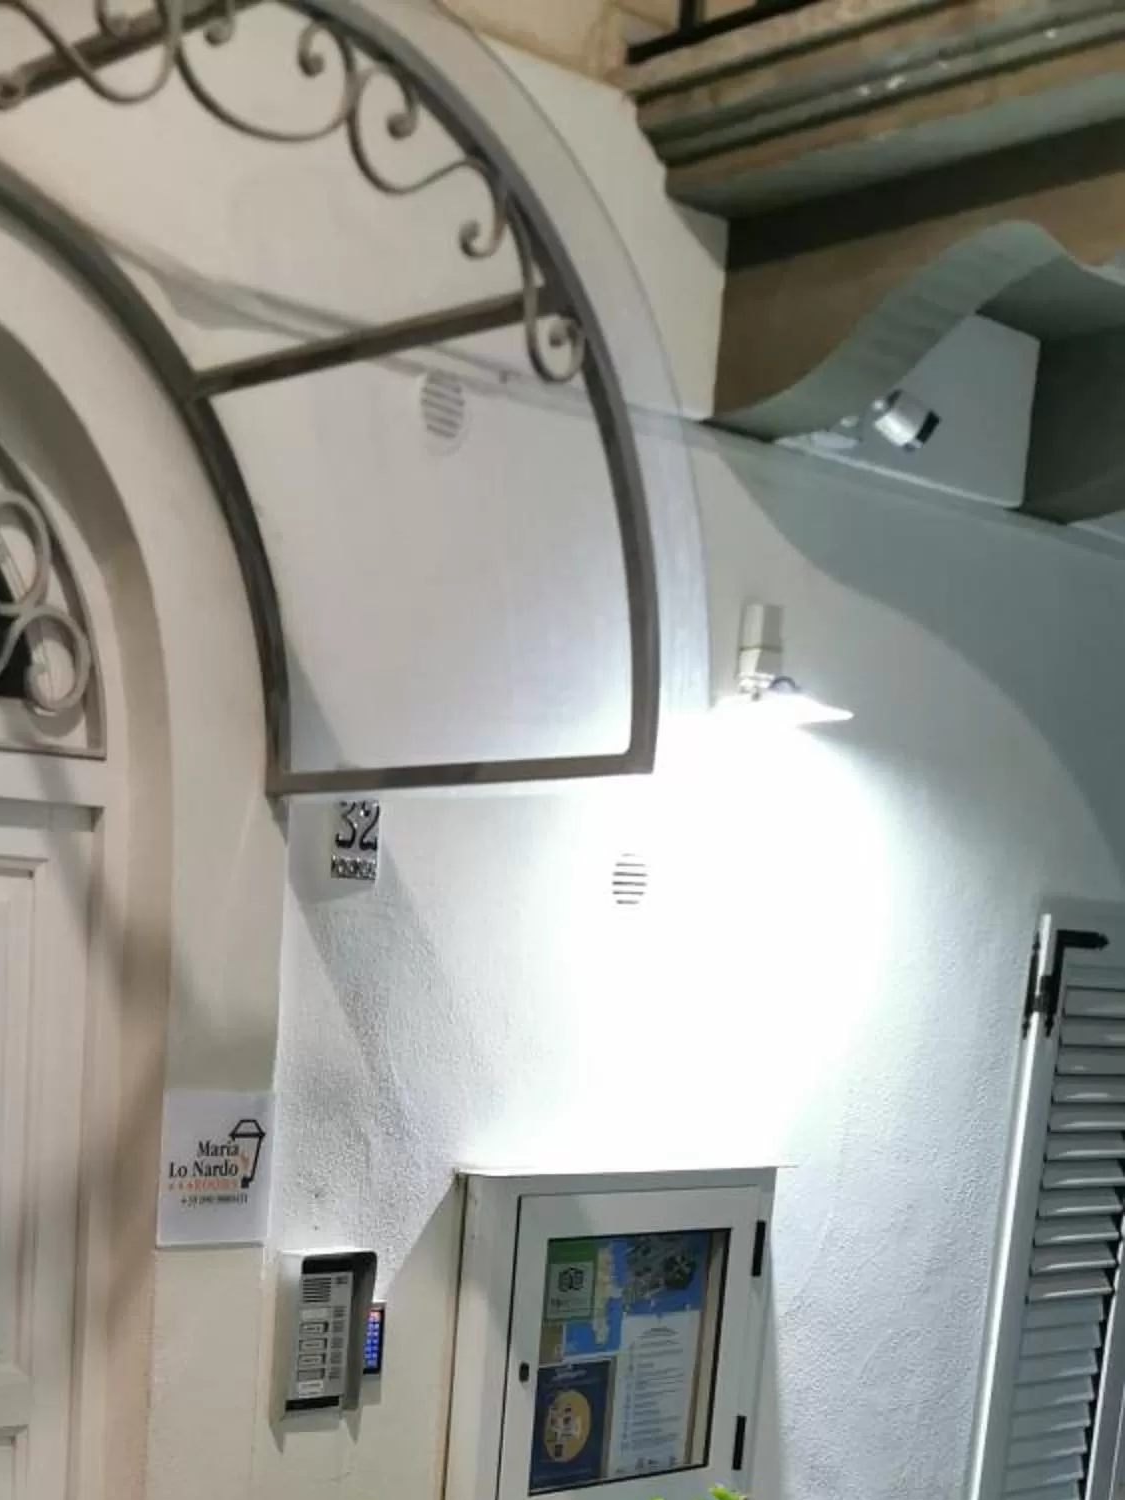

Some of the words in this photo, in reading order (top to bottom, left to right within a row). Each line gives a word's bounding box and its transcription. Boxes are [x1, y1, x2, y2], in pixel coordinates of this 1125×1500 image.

[334, 800, 380, 851] 32
[197, 1140, 240, 1157] Maria
[169, 1161, 188, 1179] Lo
[192, 1159, 239, 1178] Nardo
